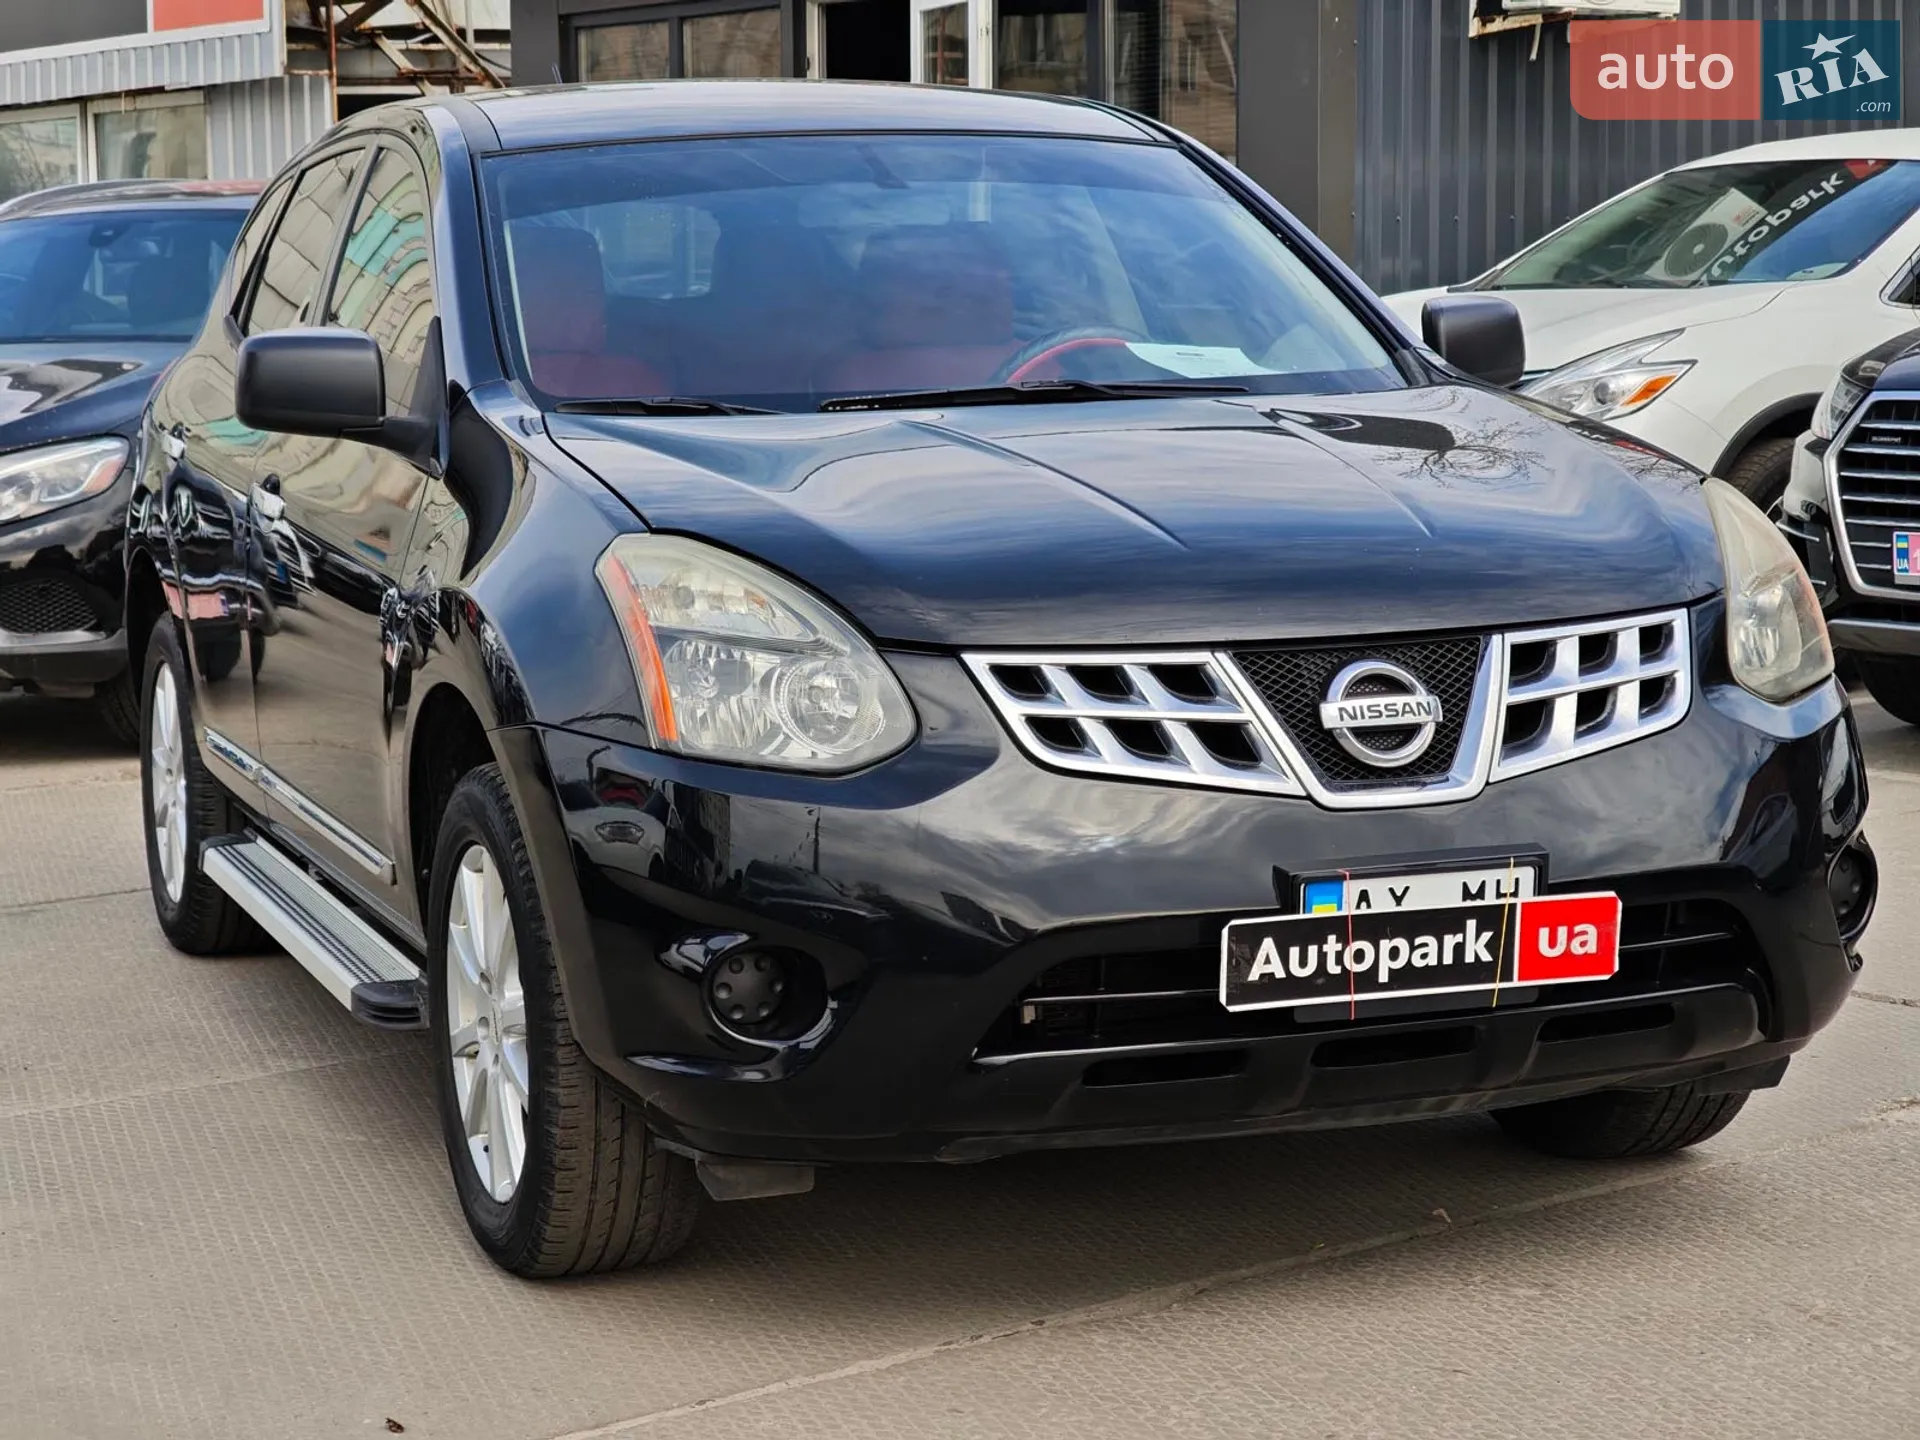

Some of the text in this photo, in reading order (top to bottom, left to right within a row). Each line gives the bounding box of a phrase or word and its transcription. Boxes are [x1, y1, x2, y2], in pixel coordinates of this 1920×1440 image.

[1896, 558, 1910, 570] UA
[1337, 701, 1433, 722] NISSAN
[1247, 918, 1598, 983] Autopark ua
